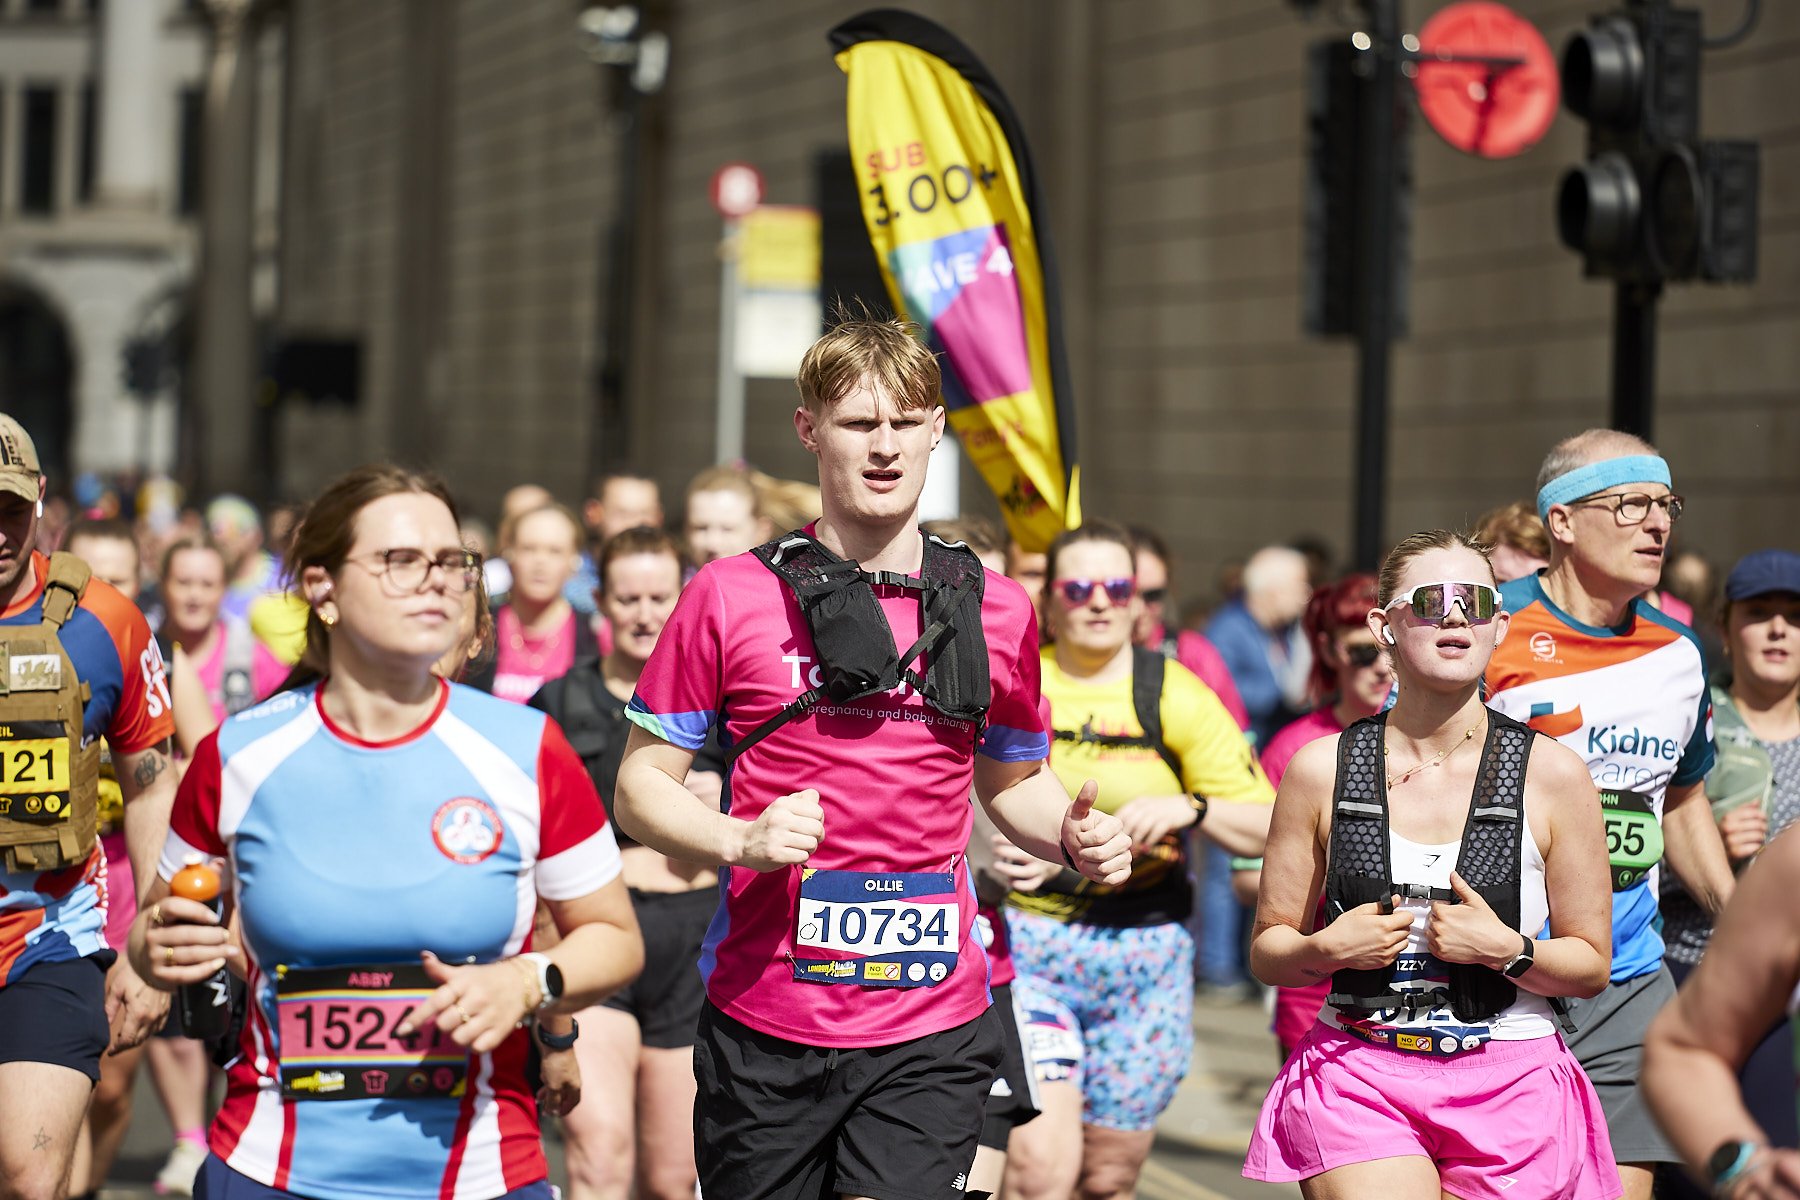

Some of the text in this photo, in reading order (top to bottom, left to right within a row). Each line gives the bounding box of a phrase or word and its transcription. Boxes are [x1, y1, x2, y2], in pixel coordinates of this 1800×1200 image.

[867, 142, 926, 180] SUB
[903, 245, 1014, 295] AVE 4
[807, 704, 874, 718] pregnancy
[877, 709, 901, 719] and
[904, 709, 934, 725] baby
[937, 715, 970, 733] charity
[1587, 725, 1678, 761] Kidne
[864, 879, 904, 892] OLLIE
[813, 906, 949, 946] 10734
[348, 972, 393, 986] ABBY
[1396, 959, 1427, 971] IZZY
[294, 1004, 441, 1050] 1524
